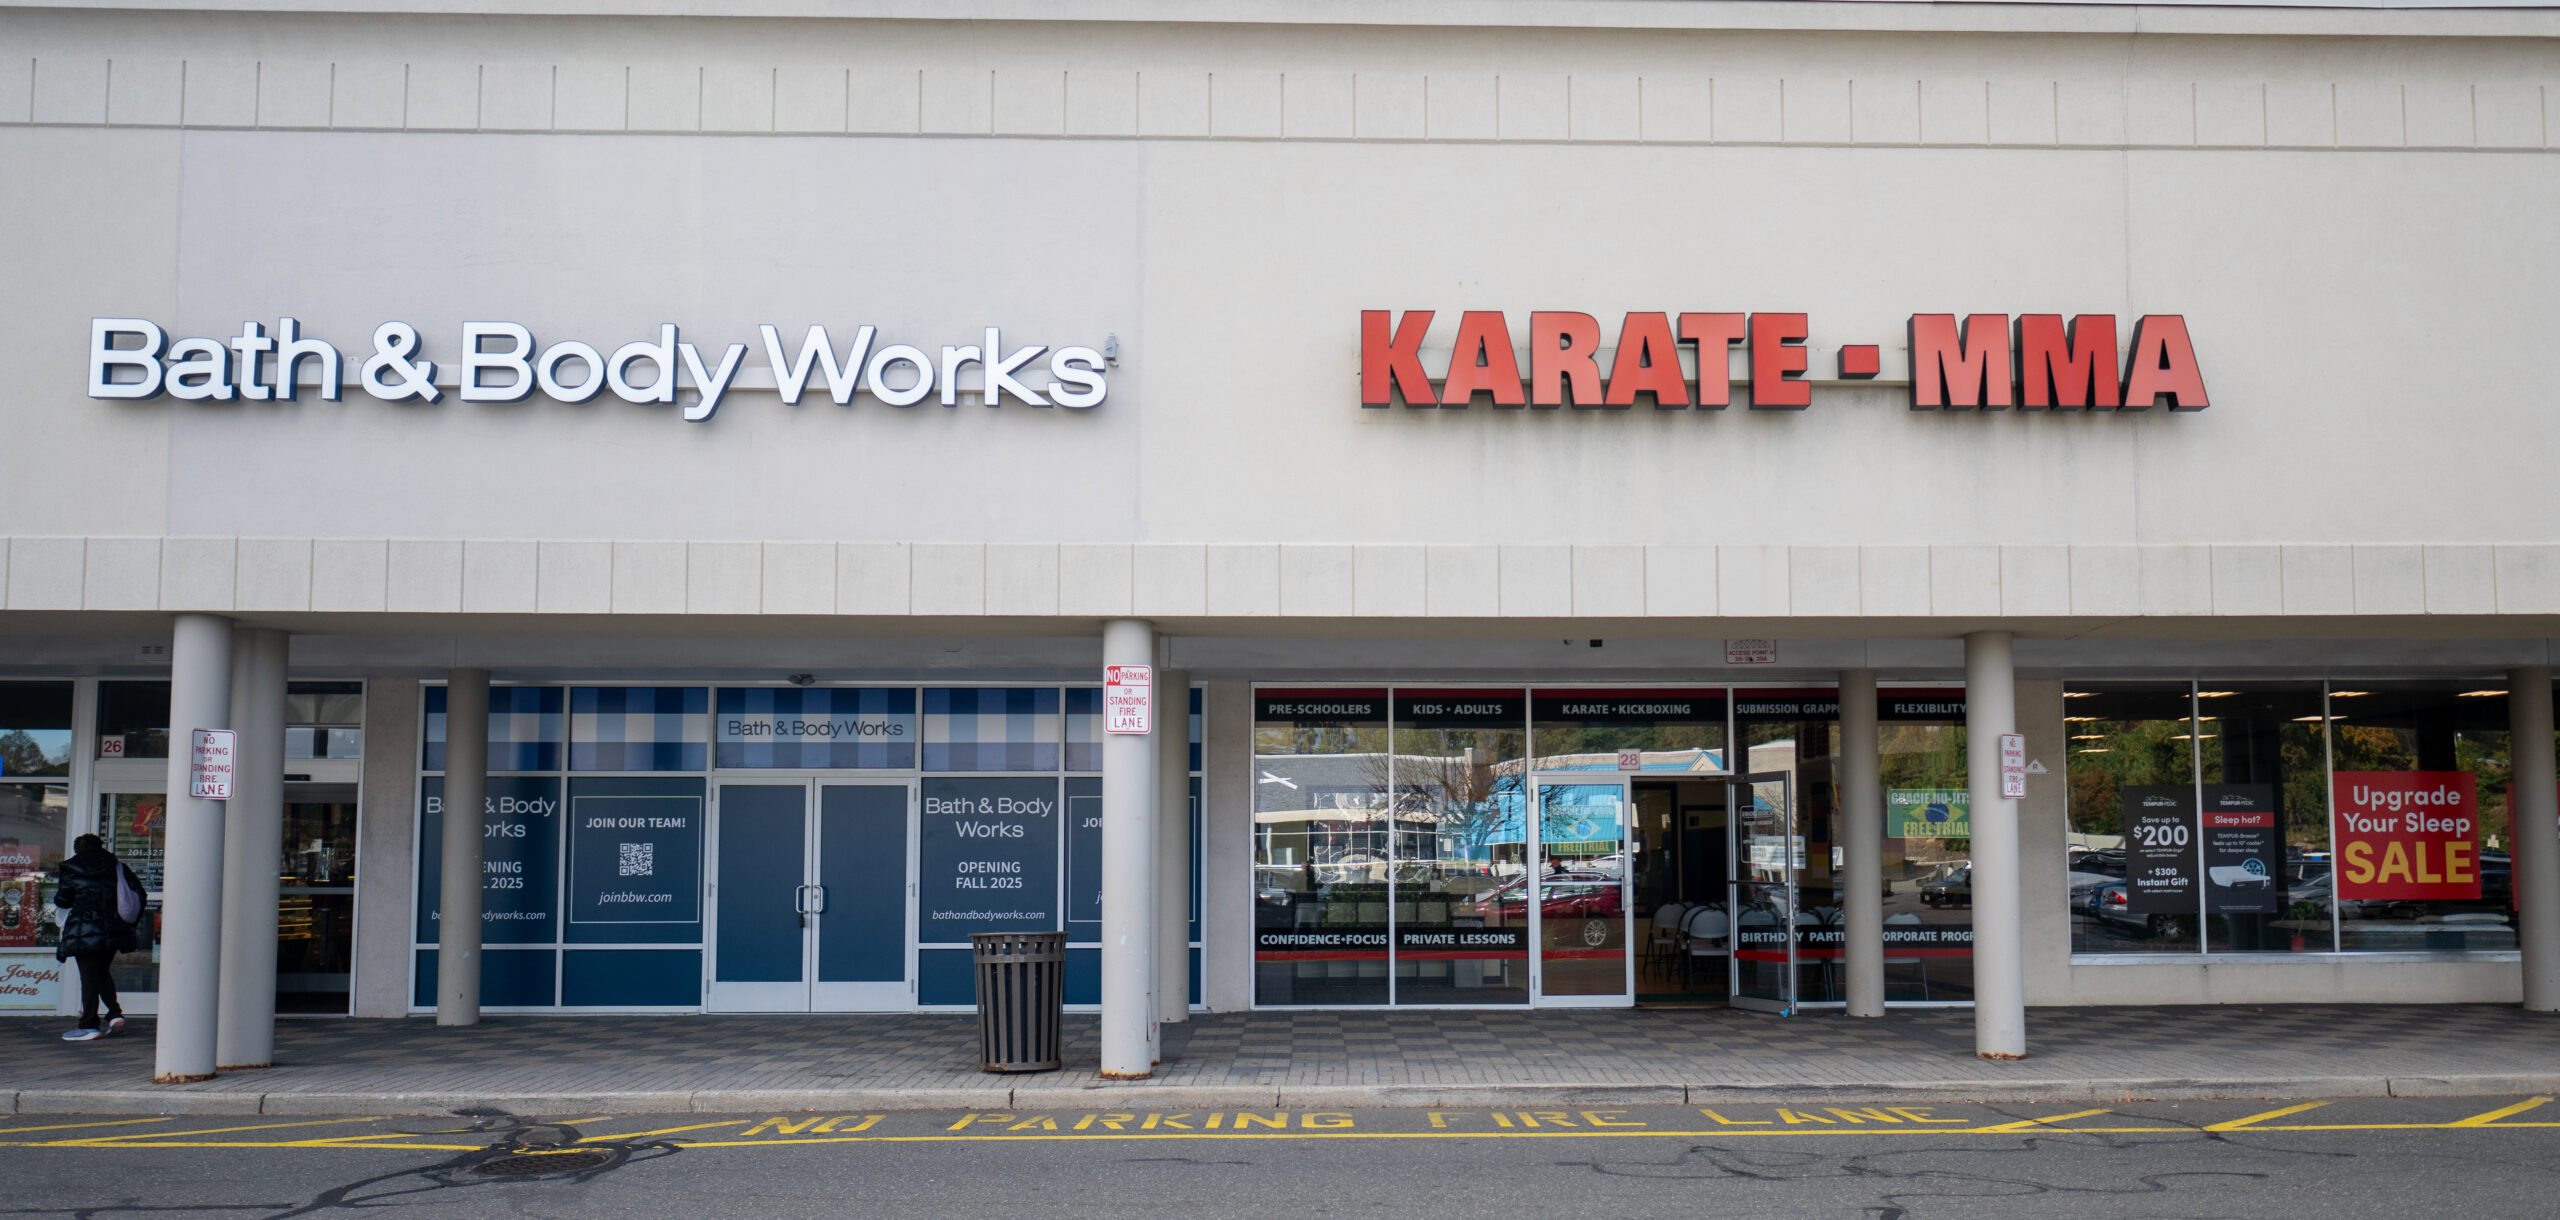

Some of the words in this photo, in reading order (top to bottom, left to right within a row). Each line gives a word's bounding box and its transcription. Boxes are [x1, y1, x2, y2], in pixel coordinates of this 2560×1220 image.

[1361, 310, 1811, 411] KARATE
[1907, 313, 2210, 412] MMA
[88, 317, 343, 403] Bath
[360, 320, 444, 405] &
[460, 321, 747, 423] Body
[759, 324, 1107, 408] Works
[1107, 669, 1120, 683] NO
[1121, 672, 1149, 681] PARKING
[1109, 697, 1147, 706] STANDING
[1119, 707, 1136, 716] FIRE
[1269, 704, 1372, 715] PRE-SCHOOLERS
[1413, 704, 1443, 715] KIDS
[1454, 704, 1503, 715] ADULTS
[1562, 704, 1609, 714] KARATE
[1619, 704, 1691, 715] KICKBOXING
[1736, 704, 1799, 714] SUBMISSION
[1114, 717, 1143, 728] LANE
[728, 720, 771, 736] Bath
[775, 720, 789, 736] &
[792, 720, 842, 739] Body
[845, 721, 904, 736] Works
[104, 740, 122, 753] 26
[204, 736, 215, 745] NO
[195, 746, 229, 755] PARKING
[1621, 754, 1639, 766] 28
[193, 764, 231, 773] STANDING
[200, 775, 217, 783] FIRE
[195, 783, 225, 795] LANE
[2007, 783, 2022, 793] LANE
[1891, 793, 1930, 805] GRACIE
[2353, 785, 2461, 811] Upgrade
[500, 796, 556, 817] Body
[926, 798, 975, 814] Bath
[978, 797, 994, 814] &
[998, 797, 1053, 818] Body
[586, 818, 616, 828] JOIN
[618, 818, 646, 828] OUR
[648, 817, 686, 828] TEAM!
[1082, 817, 1102, 828] JOI
[2214, 816, 2240, 826] Sleep
[2241, 816, 2261, 824] hot?
[2343, 813, 2398, 833] Your
[2405, 812, 2470, 838] Sleep
[484, 821, 526, 837] orks
[955, 821, 1024, 838] Works
[2133, 825, 2189, 846] $200
[0, 853, 33, 865] acks
[2345, 841, 2474, 884] SALE
[484, 862, 522, 873] NING
[958, 861, 1021, 873] OPENING
[2155, 868, 2177, 876] $300
[491, 877, 524, 889] 2025
[956, 877, 988, 889] FALL
[990, 877, 1023, 889] 2025
[2137, 878, 2169, 887] Instant
[2171, 877, 2189, 886] Gift
[597, 891, 672, 906] joinbbw.com
[932, 910, 1045, 922] bathandbodyworks.com
[1404, 934, 1455, 945] PRIVATE
[1460, 934, 1516, 945] LESSONS
[1741, 932, 1803, 943] BIRTHDY
[1809, 932, 1845, 942] PARTI
[1882, 931, 1937, 942] ORPORATE
[1941, 931, 1974, 942] PROG
[0, 983, 40, 996] stries
[739, 1114, 886, 1136] NO
[946, 1112, 1354, 1132] PARKING
[1426, 1110, 1647, 1128] FIRE
[1700, 1107, 1969, 1126] LANE
